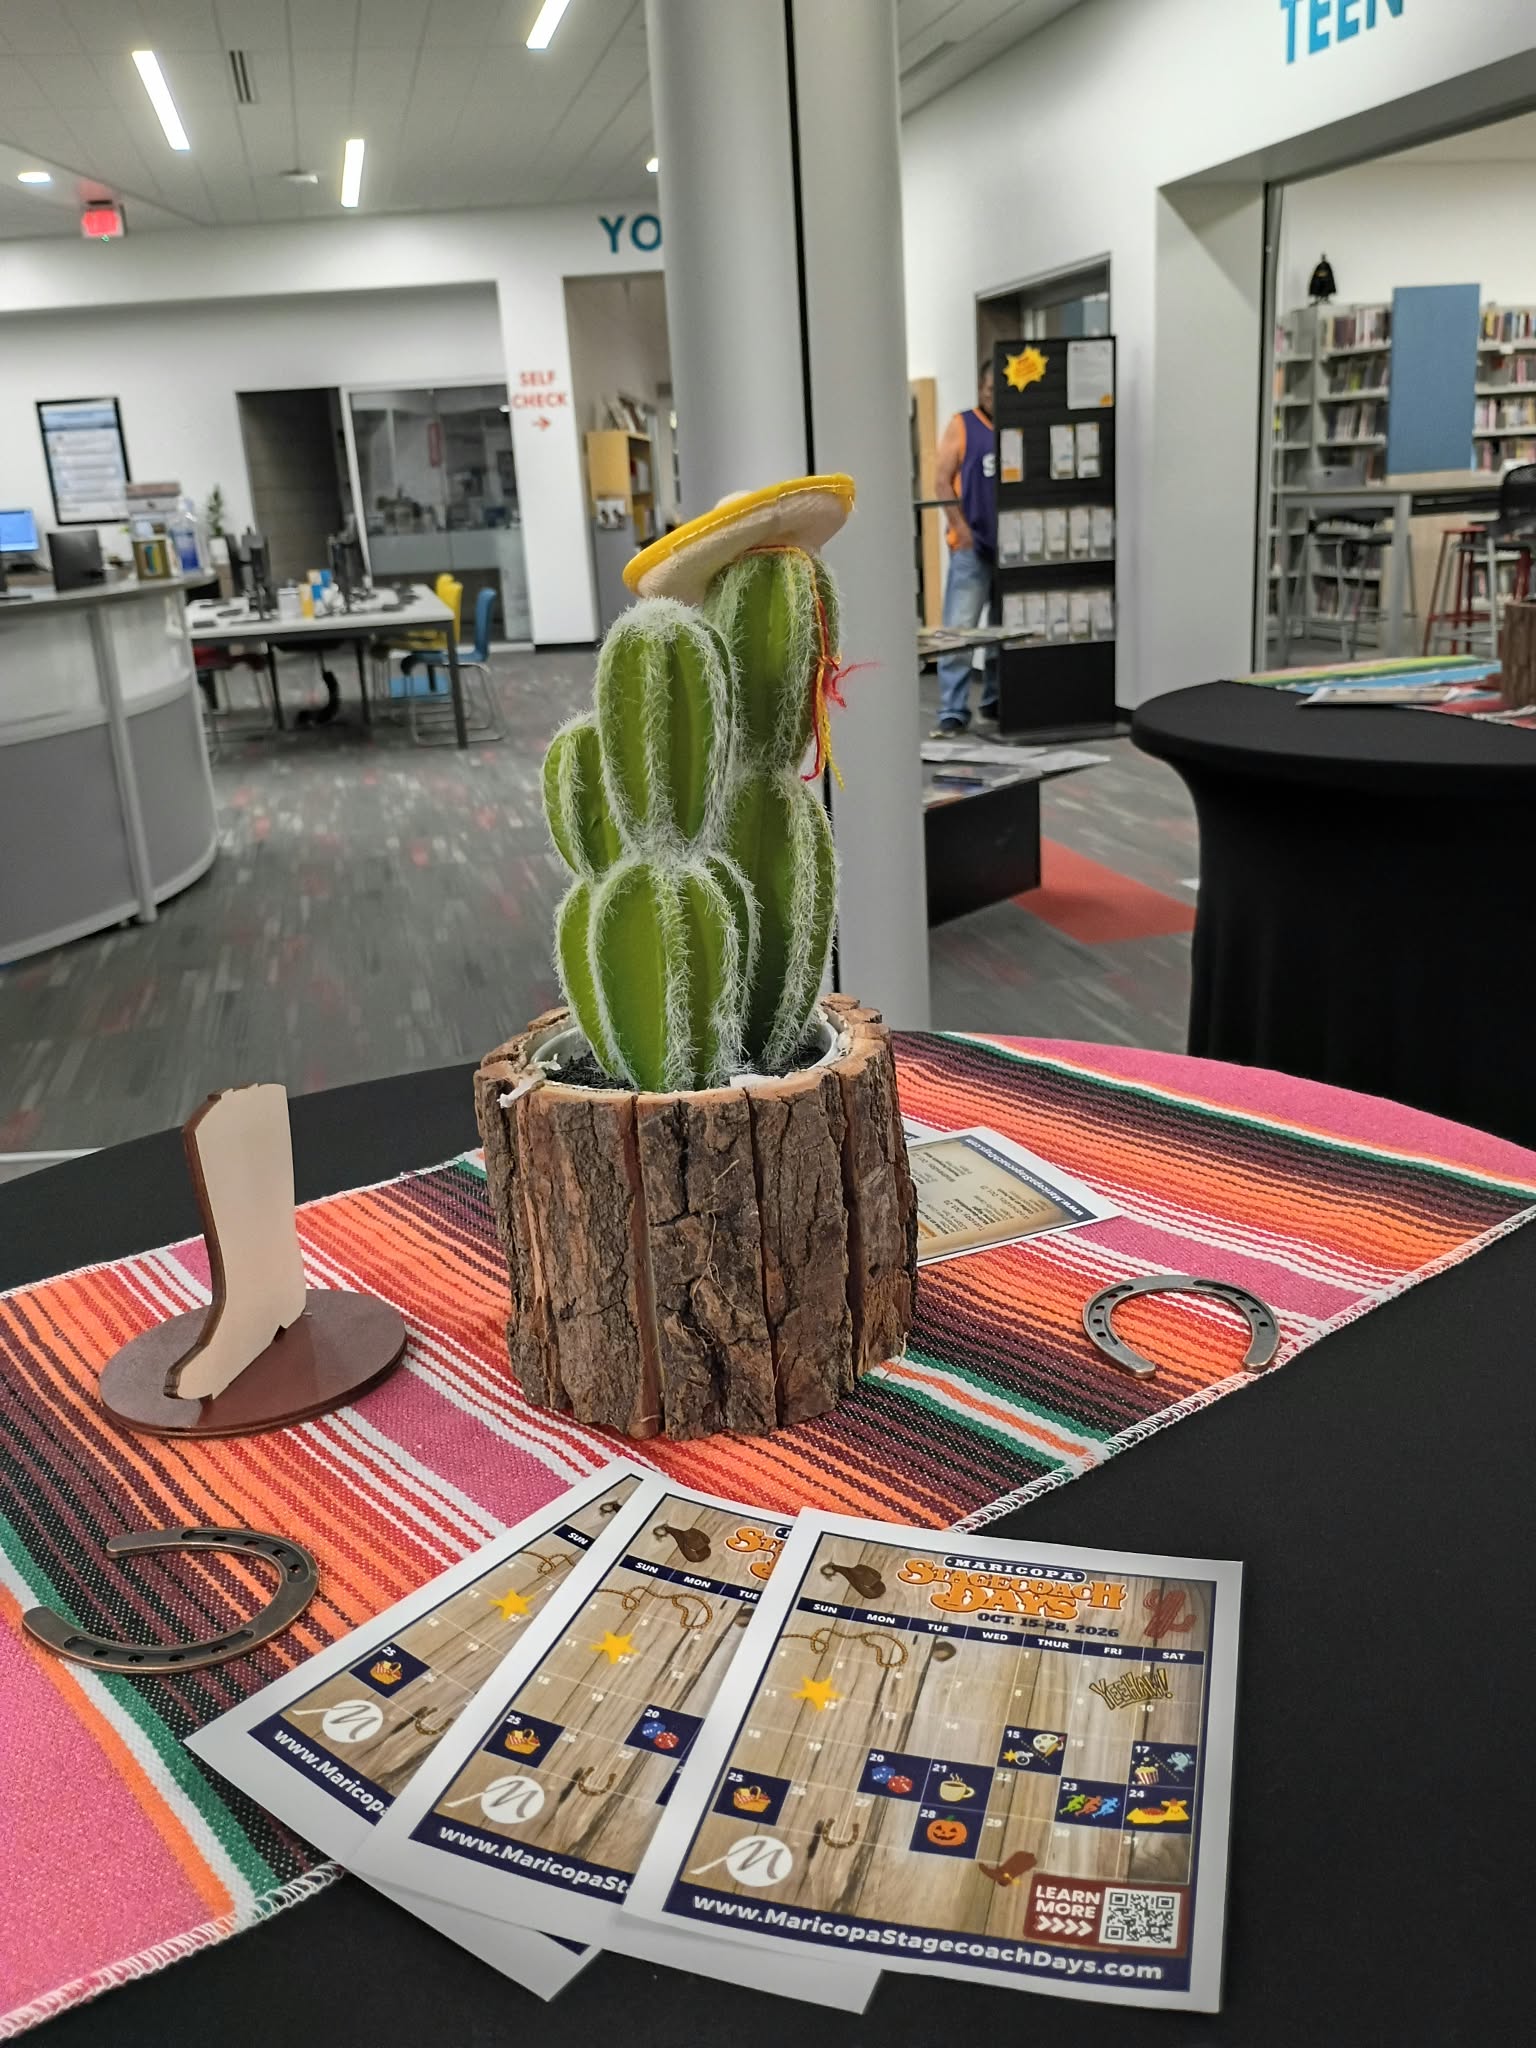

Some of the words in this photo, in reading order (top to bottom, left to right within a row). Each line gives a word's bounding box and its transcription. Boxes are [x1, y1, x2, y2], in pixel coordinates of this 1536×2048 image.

[519, 370, 556, 387] SELF
[512, 392, 566, 409] CHECK
[567, 1532, 589, 1545] SUN
[635, 1562, 659, 1574] SUN
[683, 1576, 711, 1588] MON
[738, 1589, 759, 1600] TUE
[954, 1558, 1076, 1581] MARICOPA
[468, 1590, 480, 1598] 11
[897, 1558, 1127, 1610] STAGECOACH
[930, 1581, 1079, 1621] DAYS
[813, 1602, 838, 1615] SUN
[866, 1612, 896, 1625] MON
[927, 1622, 949, 1633] TUE
[982, 1630, 1008, 1641] WED
[1037, 1638, 1070, 1649] THUR
[1103, 1646, 1123, 1656] FRI
[1162, 1651, 1186, 1661] SAT
[977, 1612, 1015, 1625] OCT.
[1020, 1616, 1069, 1634] 15-28,
[1075, 1624, 1119, 1638] 2026
[382, 1646, 397, 1658] 25
[564, 1638, 578, 1648] 11
[617, 1655, 631, 1664] 12
[1022, 1651, 1030, 1659] 1
[505, 1714, 522, 1725] 25
[644, 1708, 660, 1719] 20
[1140, 1704, 1155, 1712] 10
[764, 1689, 778, 1698] 11
[823, 1702, 838, 1710] 12
[1006, 1730, 1021, 1740] 15
[1135, 1744, 1150, 1754] 17
[748, 1730, 761, 1739] 18
[808, 1742, 822, 1752] 19
[868, 1753, 886, 1763] 20
[932, 1763, 948, 1773] 21
[996, 1772, 1012, 1782] 22
[1062, 1782, 1078, 1792] 23
[1128, 1789, 1146, 1798] 24
[728, 1771, 744, 1783] 25
[790, 1786, 807, 1796] 26
[856, 1798, 872, 1808] 27
[920, 1808, 936, 1819] 28
[986, 1818, 1002, 1828] 29
[439, 1825, 630, 1894] www.MaricopaSt
[1035, 1884, 1101, 1906] LEARN
[1035, 1899, 1096, 1919] MORE
[693, 1895, 1162, 1980] www.MaricopaStagecoachDays.com
